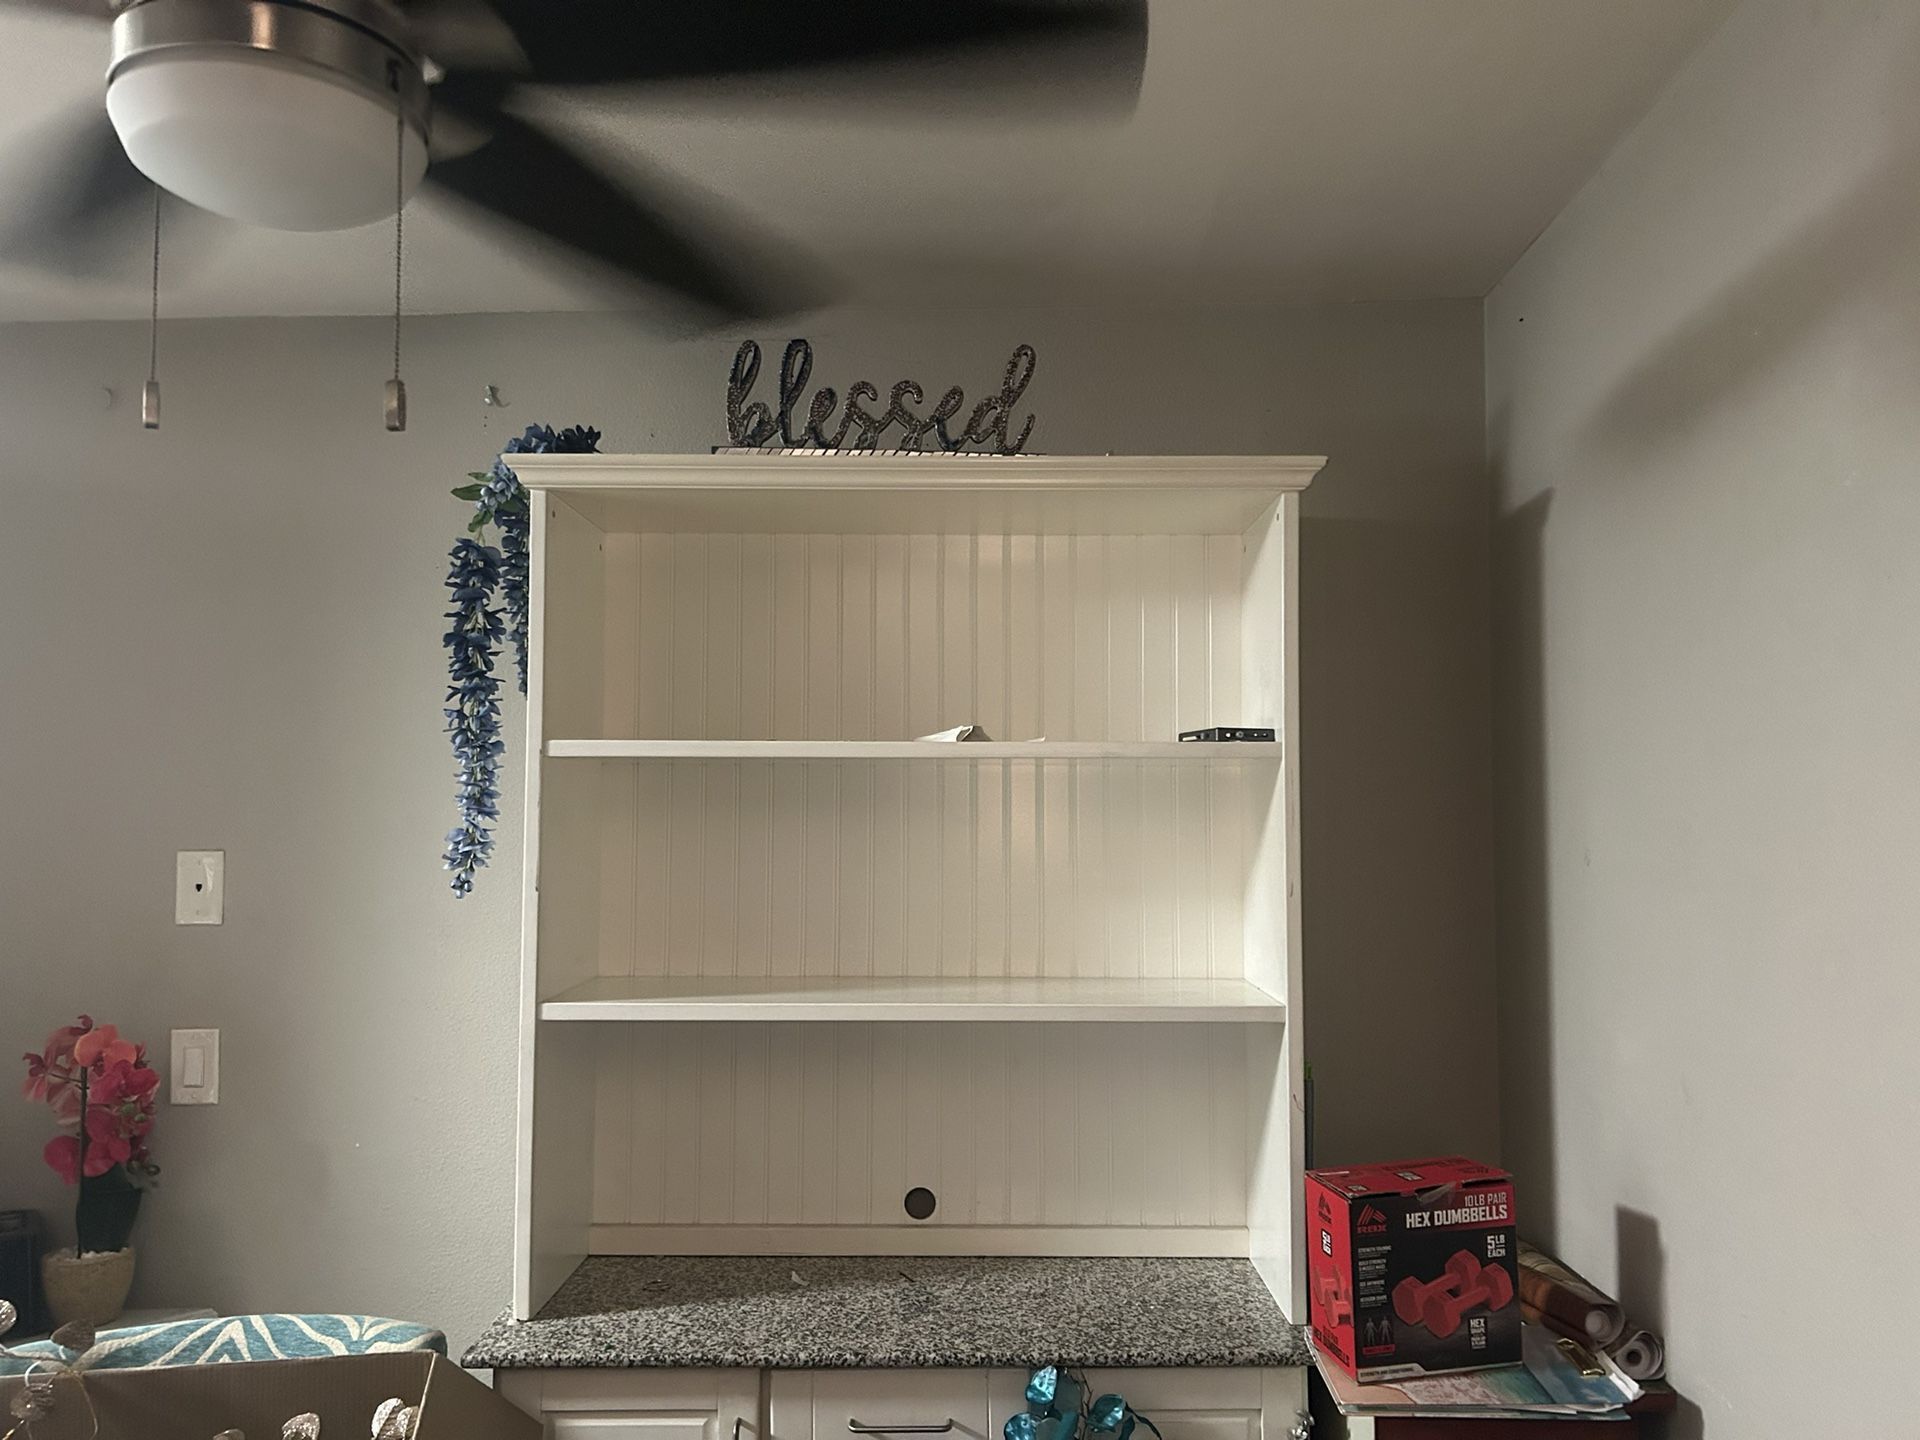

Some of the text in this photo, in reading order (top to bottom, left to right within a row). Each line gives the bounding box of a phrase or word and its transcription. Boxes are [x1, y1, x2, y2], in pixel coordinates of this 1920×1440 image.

[727, 339, 1035, 455] blessed
[1487, 1192, 1507, 1205] PAIR
[1406, 1204, 1508, 1229] HEX DUMBBELLS
[1487, 1248, 1506, 1258] EACH
